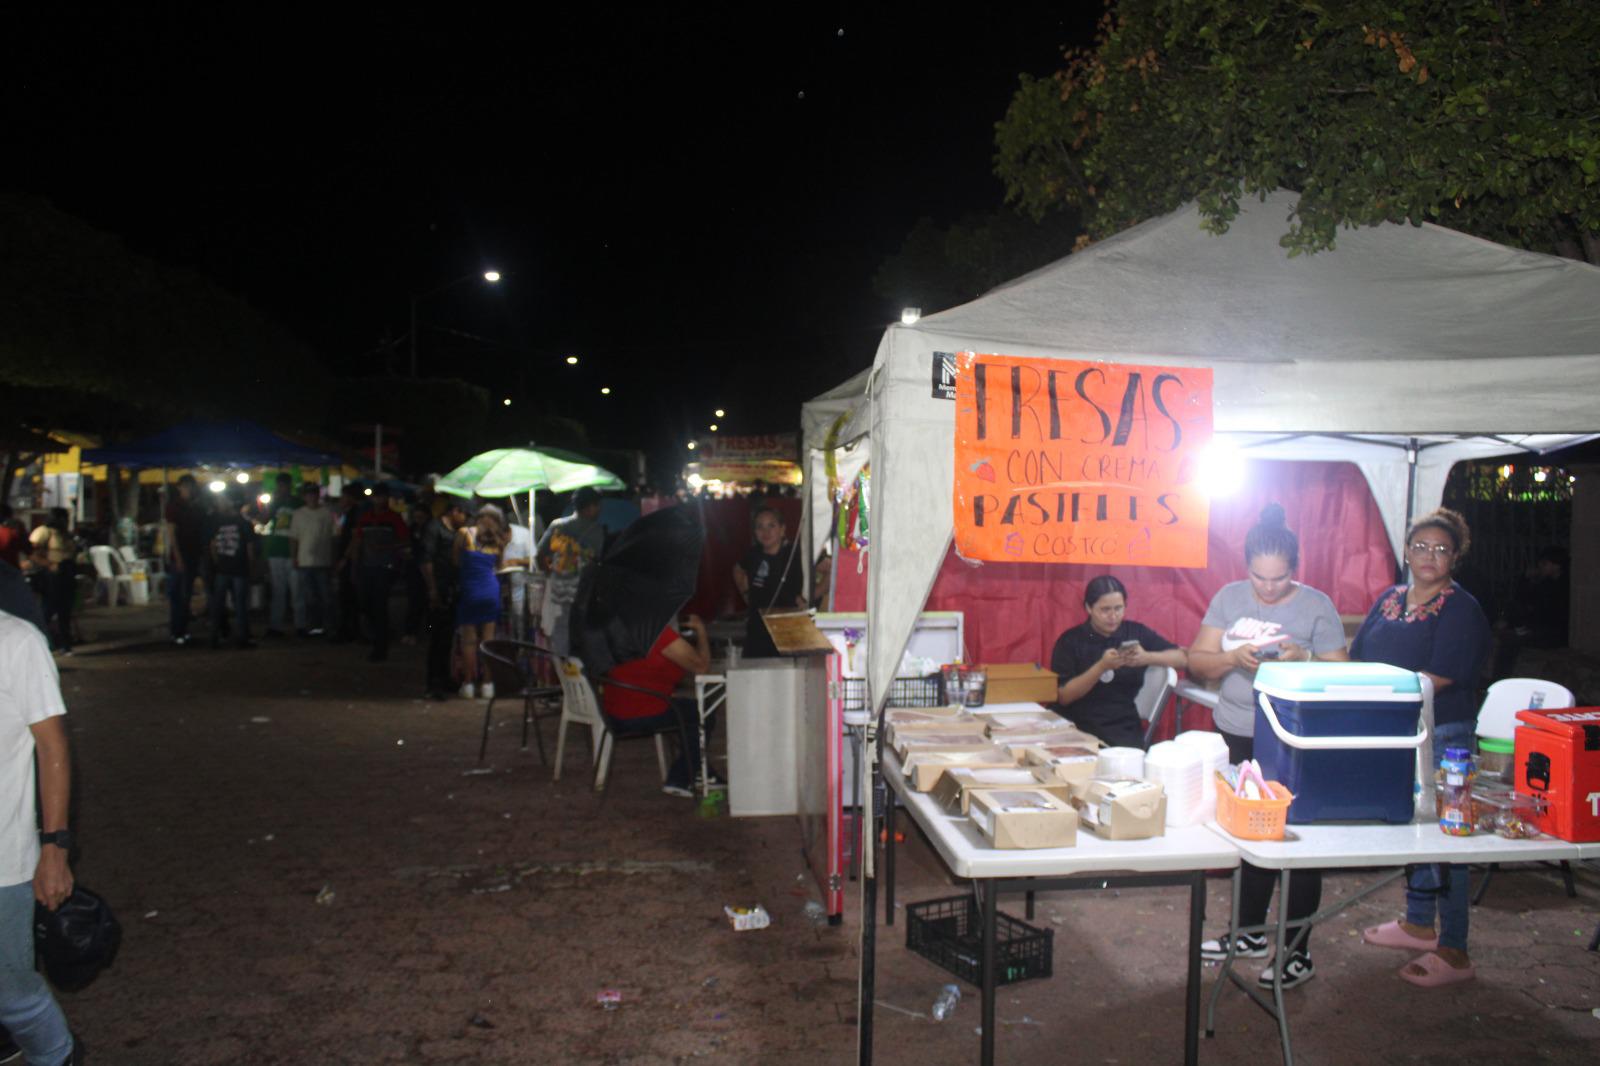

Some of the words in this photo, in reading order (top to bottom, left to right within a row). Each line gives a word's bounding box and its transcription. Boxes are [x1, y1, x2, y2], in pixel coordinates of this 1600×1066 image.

[974, 363, 1184, 450] FRESAS
[1007, 450, 1063, 485] CON
[1081, 454, 1161, 481] CREMA
[973, 493, 1181, 527] PASTELES
[1033, 533, 1118, 557] COSTCO
